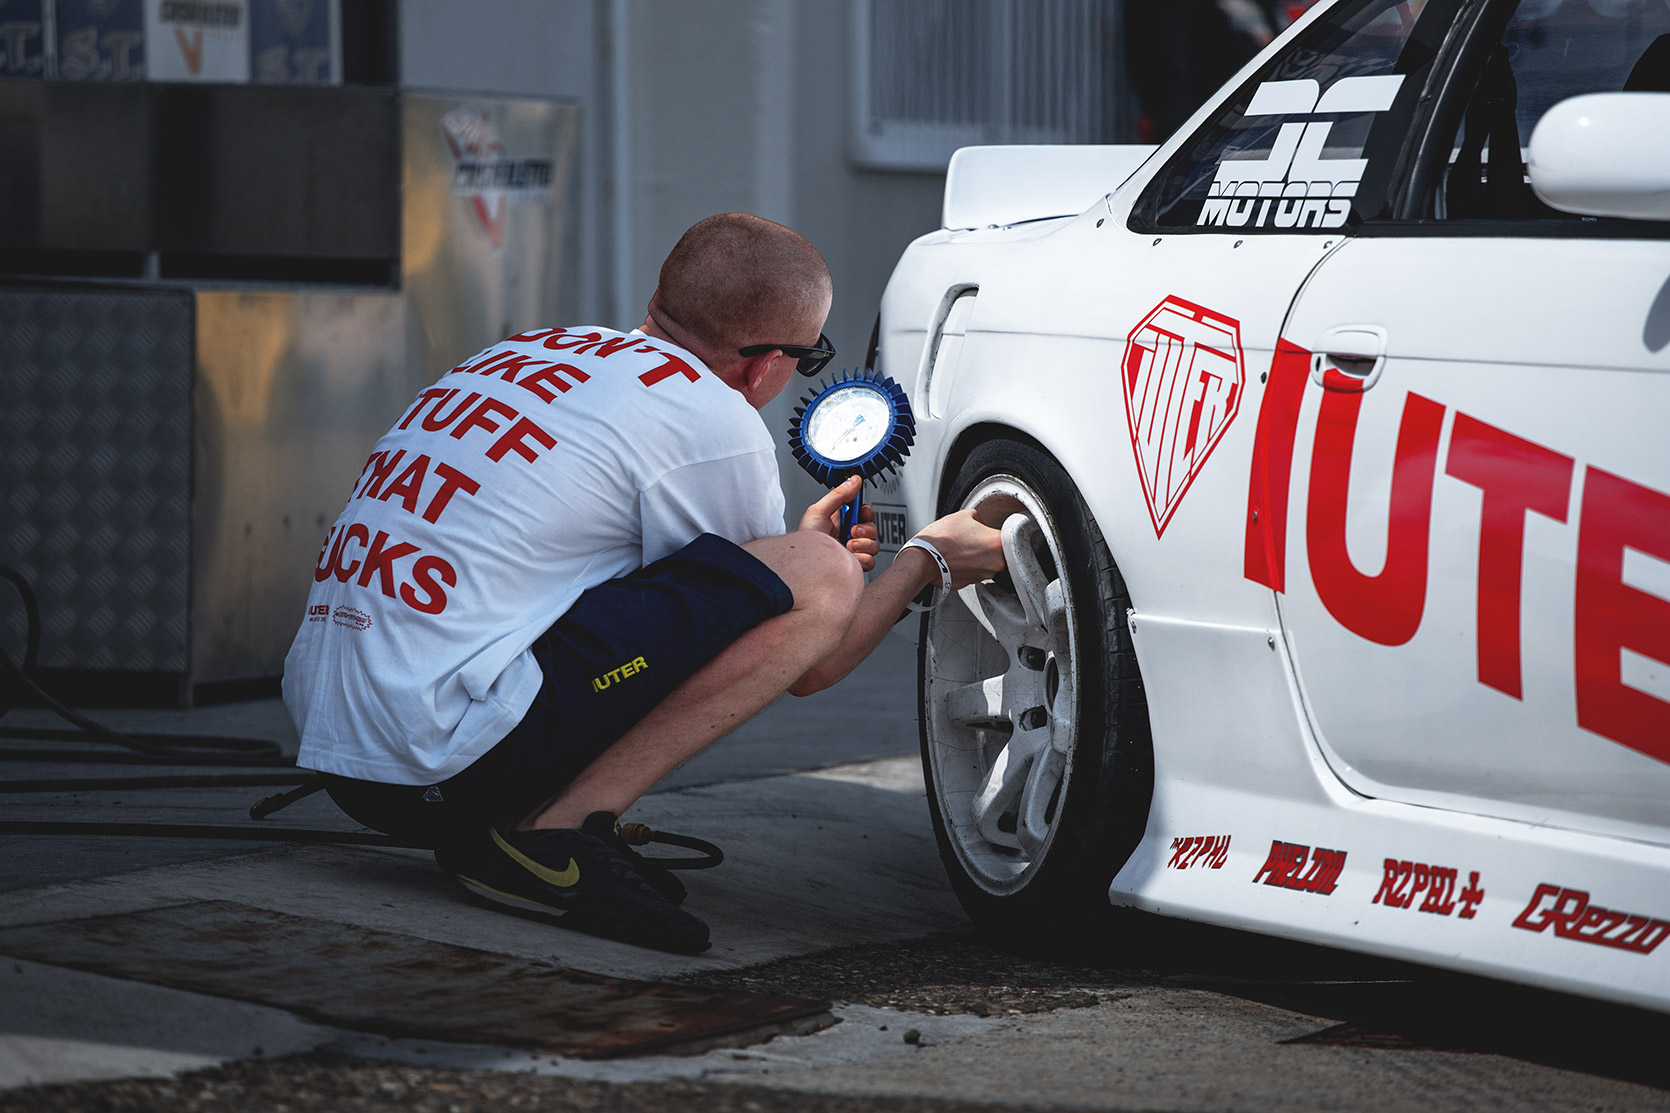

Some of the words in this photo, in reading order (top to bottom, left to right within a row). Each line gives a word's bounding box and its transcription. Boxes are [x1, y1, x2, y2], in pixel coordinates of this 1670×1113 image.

[1196, 181, 1360, 228] MOTORS
[395, 388, 558, 464] TUFF
[315, 522, 458, 615] UCKS
